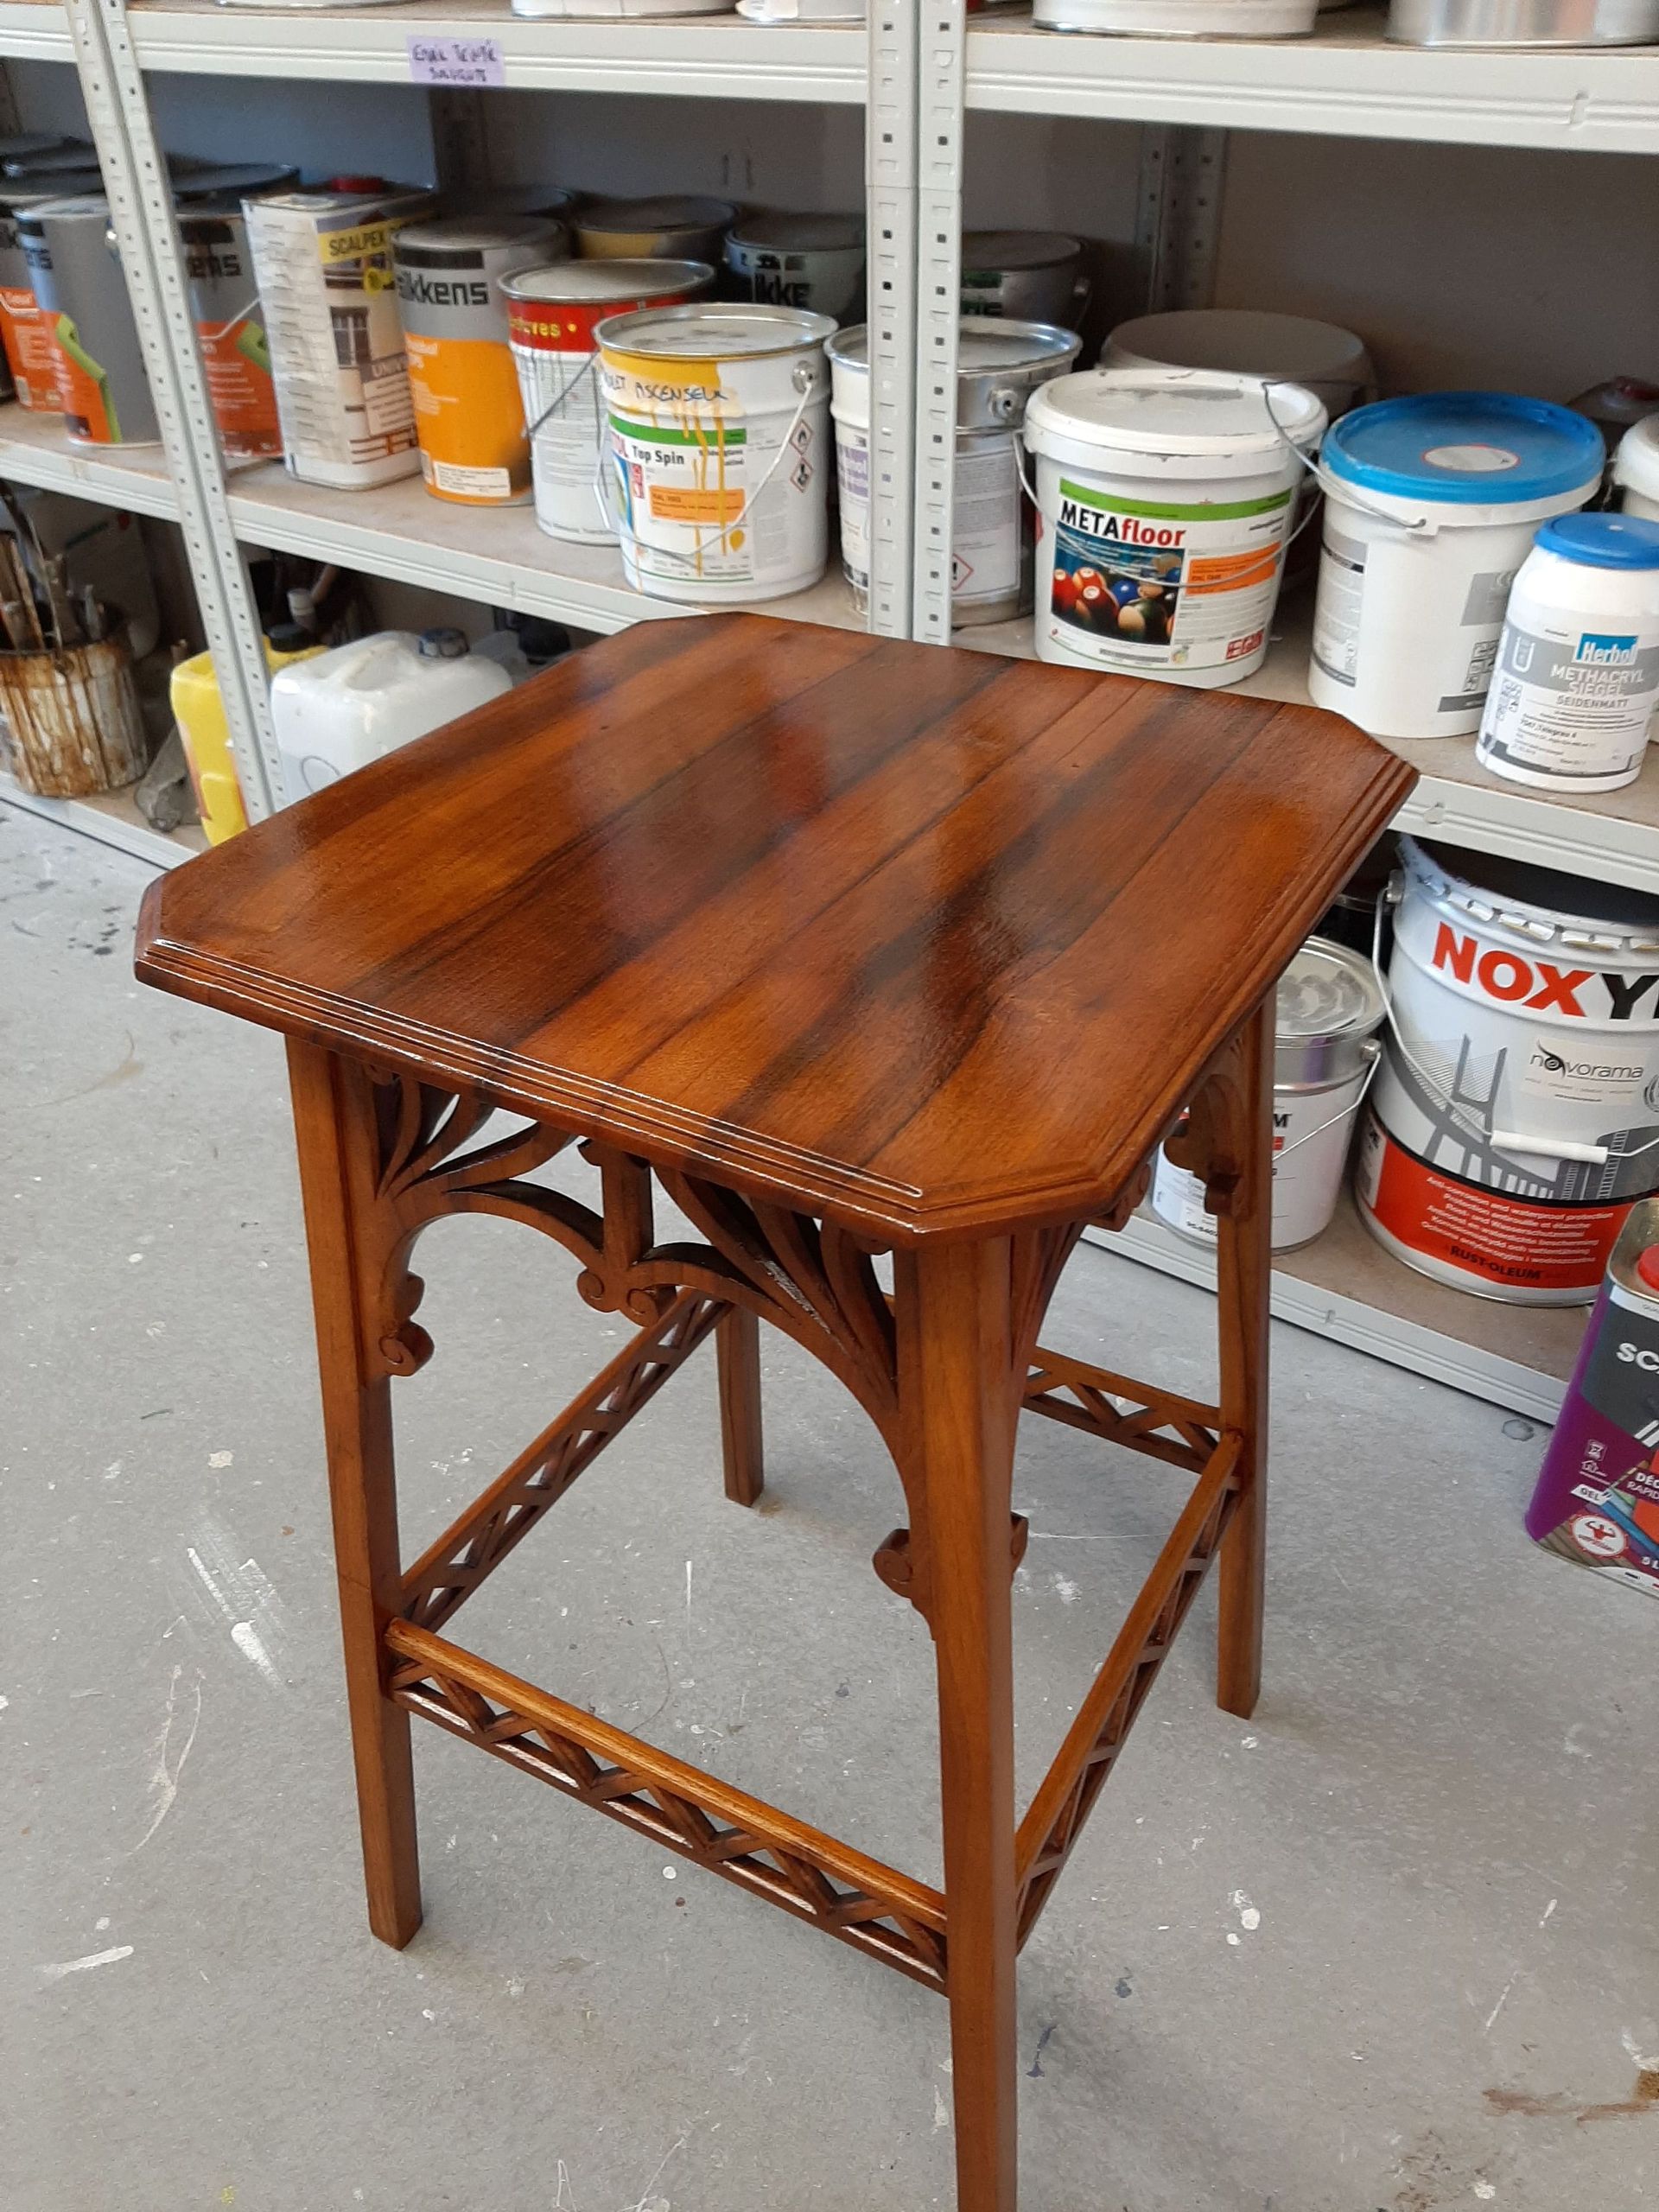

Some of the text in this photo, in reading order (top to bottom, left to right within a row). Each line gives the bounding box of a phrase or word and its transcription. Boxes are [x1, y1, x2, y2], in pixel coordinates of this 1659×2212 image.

[632, 444, 652, 463] Top
[655, 450, 684, 467] Spin
[1060, 499, 1187, 547] METAfloor
[1550, 664, 1645, 683] METHACRYL
[1555, 695, 1630, 709] SEIDENMATT
[1568, 682, 1624, 696] SIEGEL
[1433, 921, 1659, 1020] NOXY
[1451, 1244, 1543, 1281] RUST-OLEUM
[1616, 1342, 1659, 1375] SC
